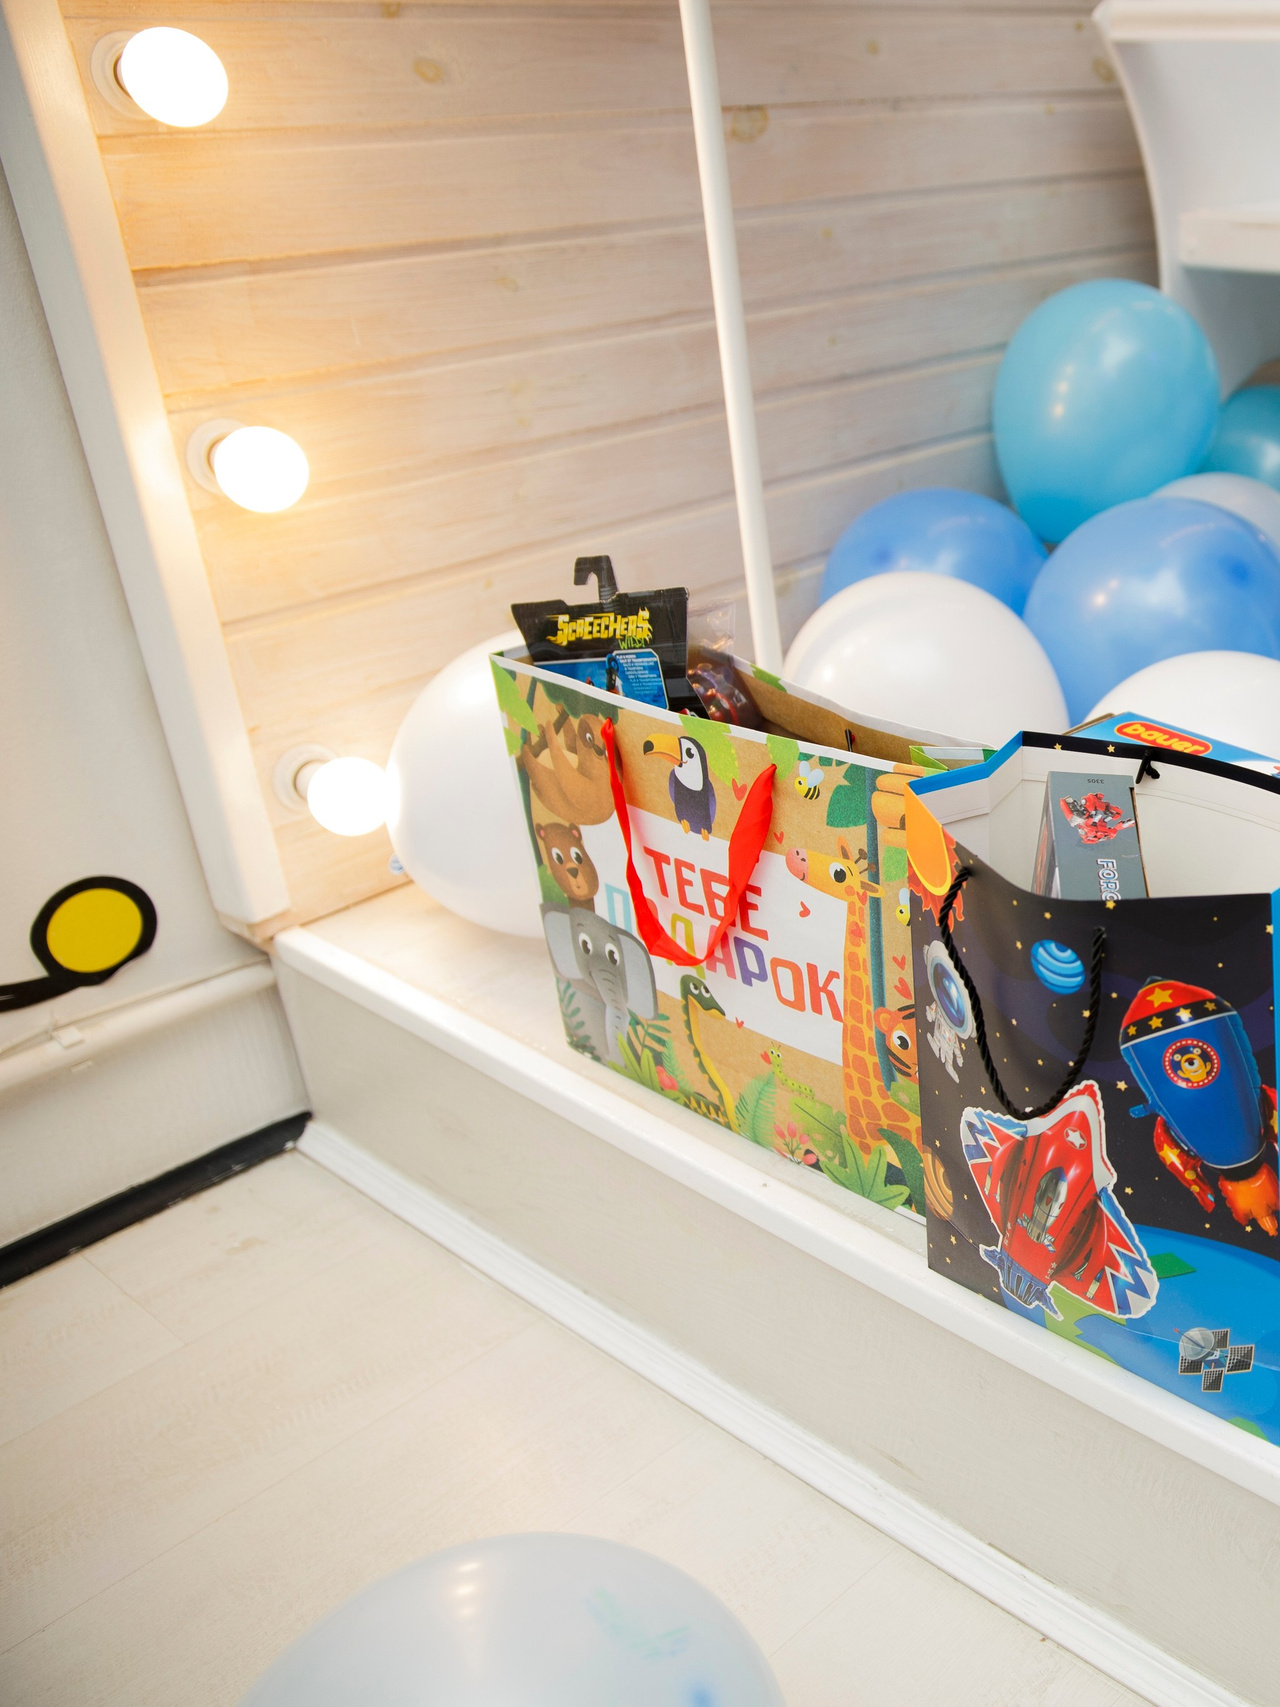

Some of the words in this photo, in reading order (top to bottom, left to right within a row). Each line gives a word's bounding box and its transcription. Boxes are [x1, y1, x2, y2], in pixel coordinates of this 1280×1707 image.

[547, 606, 653, 647] SCREECHERS
[1122, 723, 1205, 754] bauer
[643, 846, 769, 942] ТЕБЕ
[605, 882, 844, 1023] ПДАРОК
